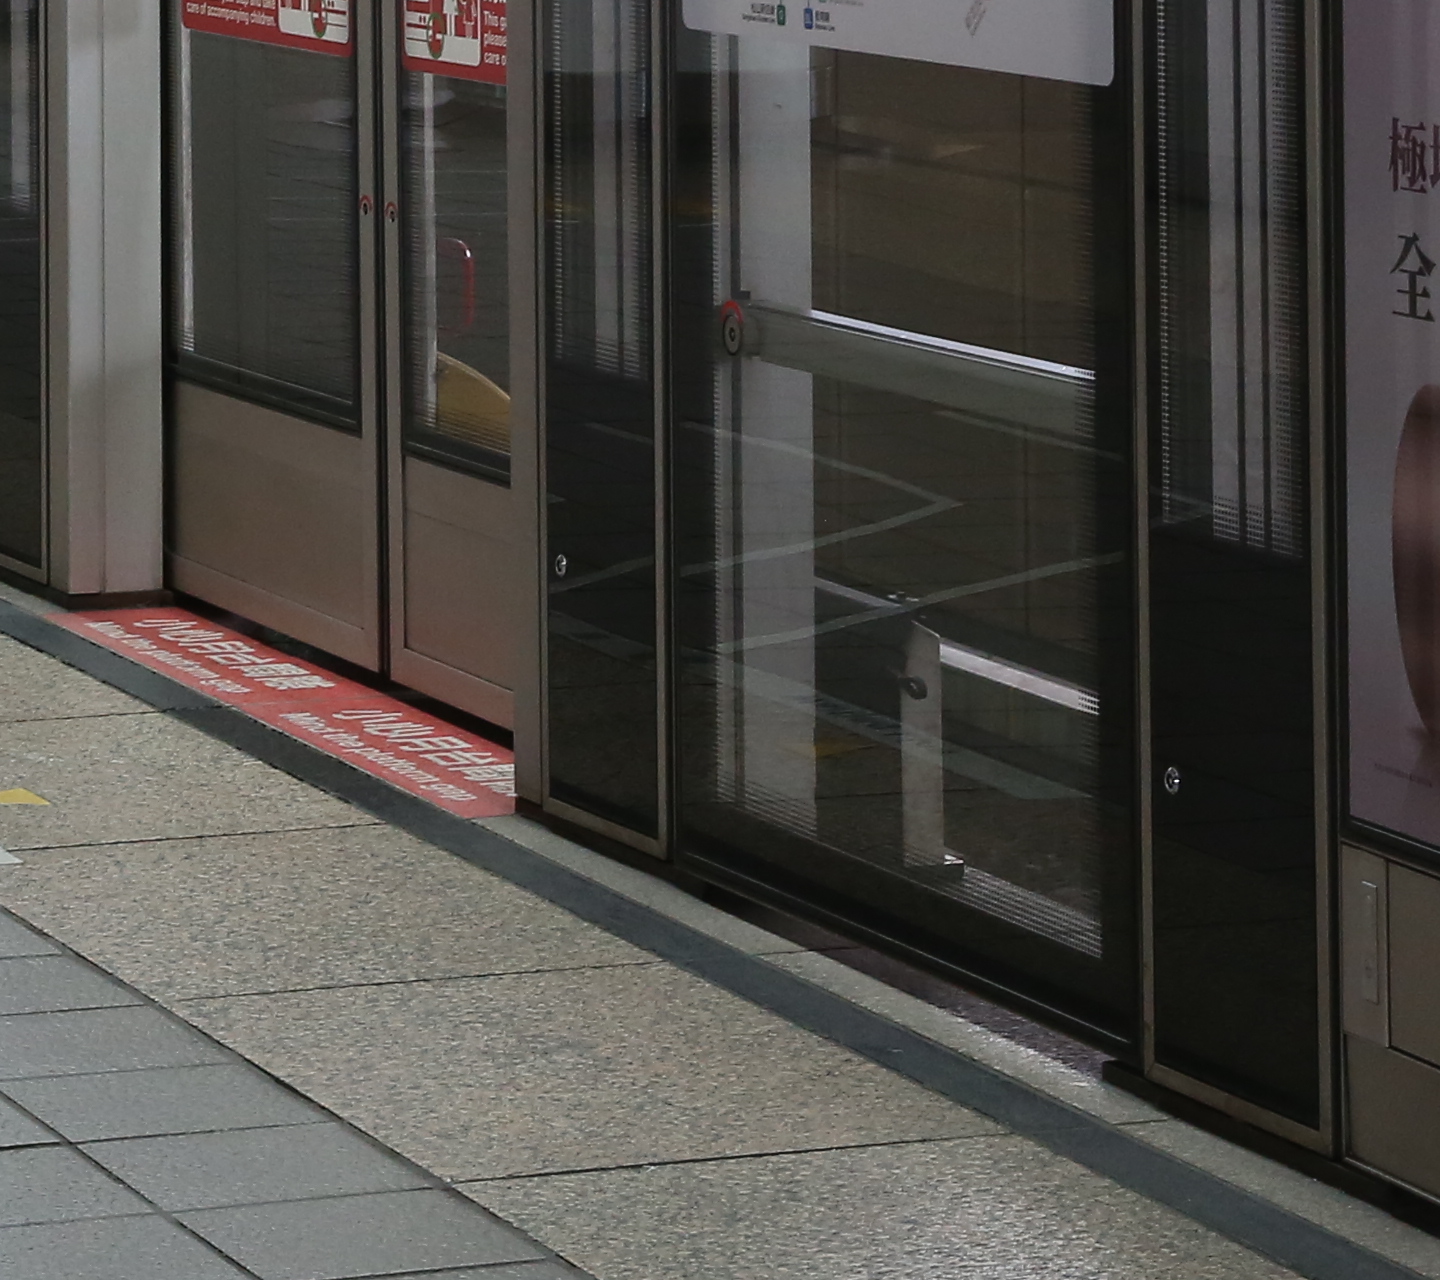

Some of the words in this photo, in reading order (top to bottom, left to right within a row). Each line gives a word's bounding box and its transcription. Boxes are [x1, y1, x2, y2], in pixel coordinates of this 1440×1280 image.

[133, 619, 337, 691] 小心月台間隙
